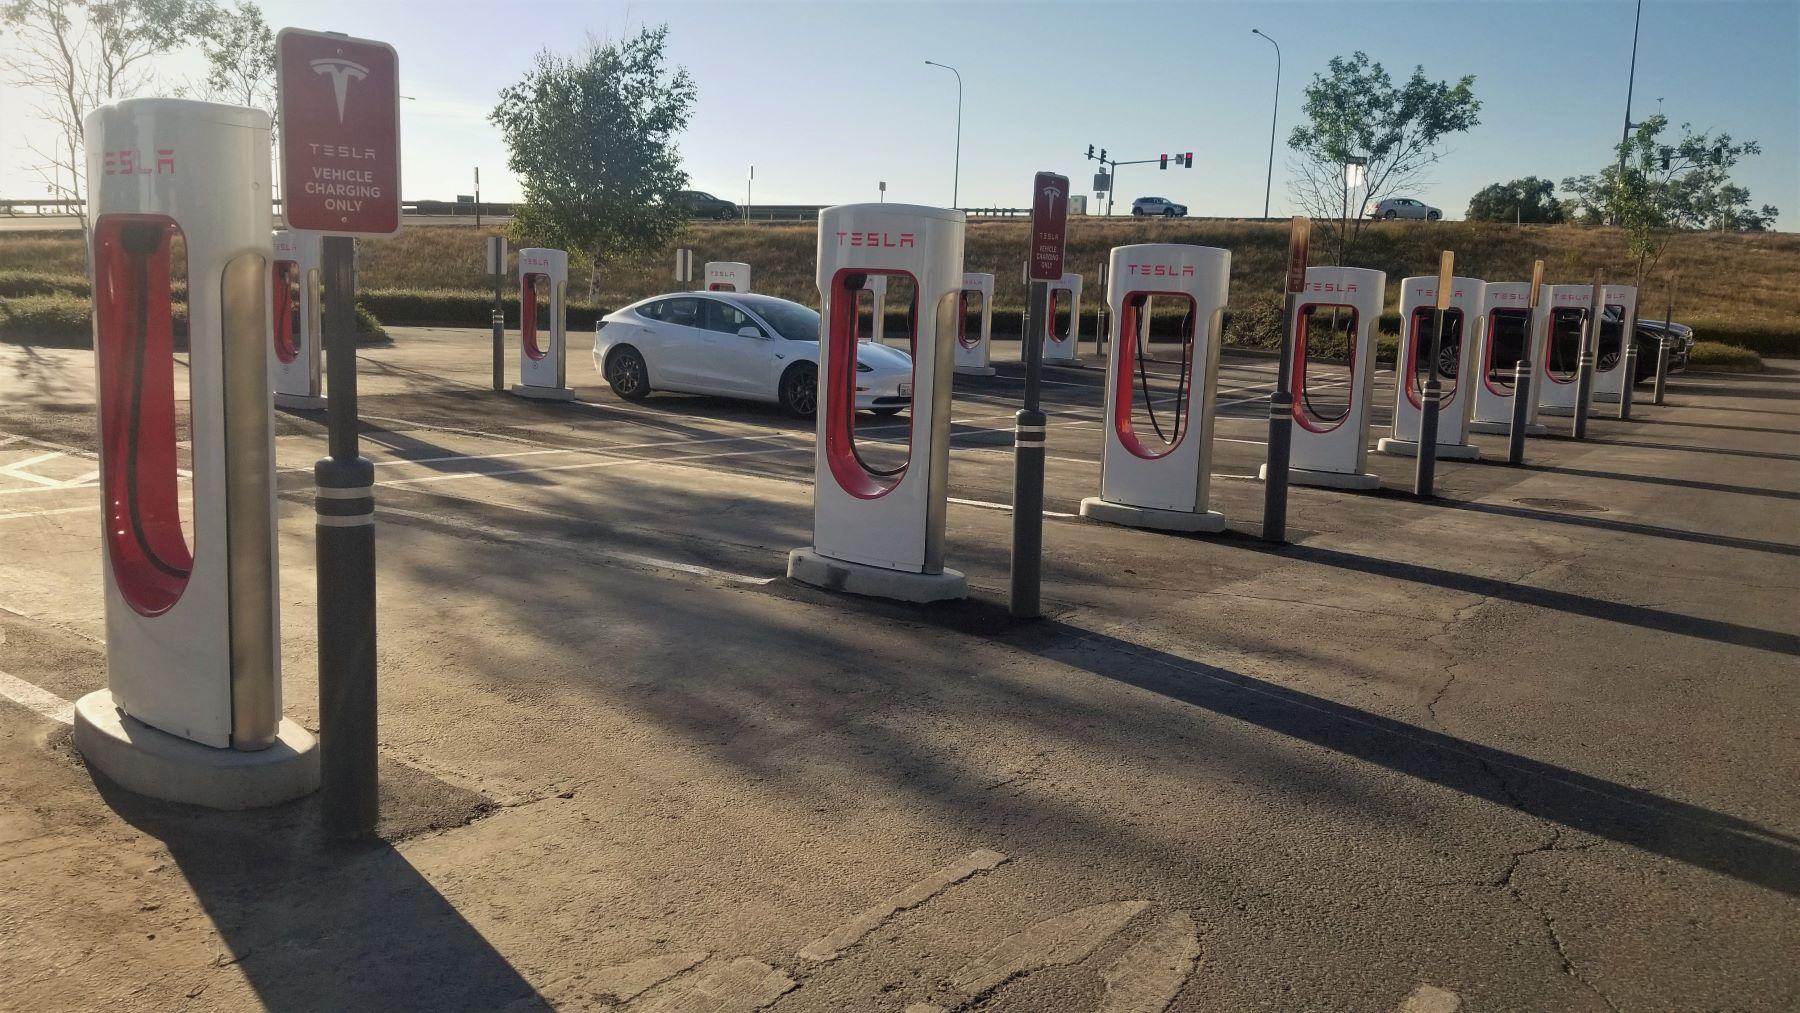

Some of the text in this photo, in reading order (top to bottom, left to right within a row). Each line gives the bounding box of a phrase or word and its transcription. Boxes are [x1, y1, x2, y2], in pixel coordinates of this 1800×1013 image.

[309, 143, 376, 160] TESLA
[312, 166, 374, 183] VEHICLE
[305, 181, 381, 199] CHARGING
[324, 198, 363, 212] ONLY
[836, 231, 914, 248] TESLA
[1039, 232, 1059, 240] TESLA
[1127, 264, 1194, 277] TESLA
[1305, 282, 1357, 293] TESLA
[1416, 288, 1463, 298] TEA
[1491, 292, 1529, 300] TESL
